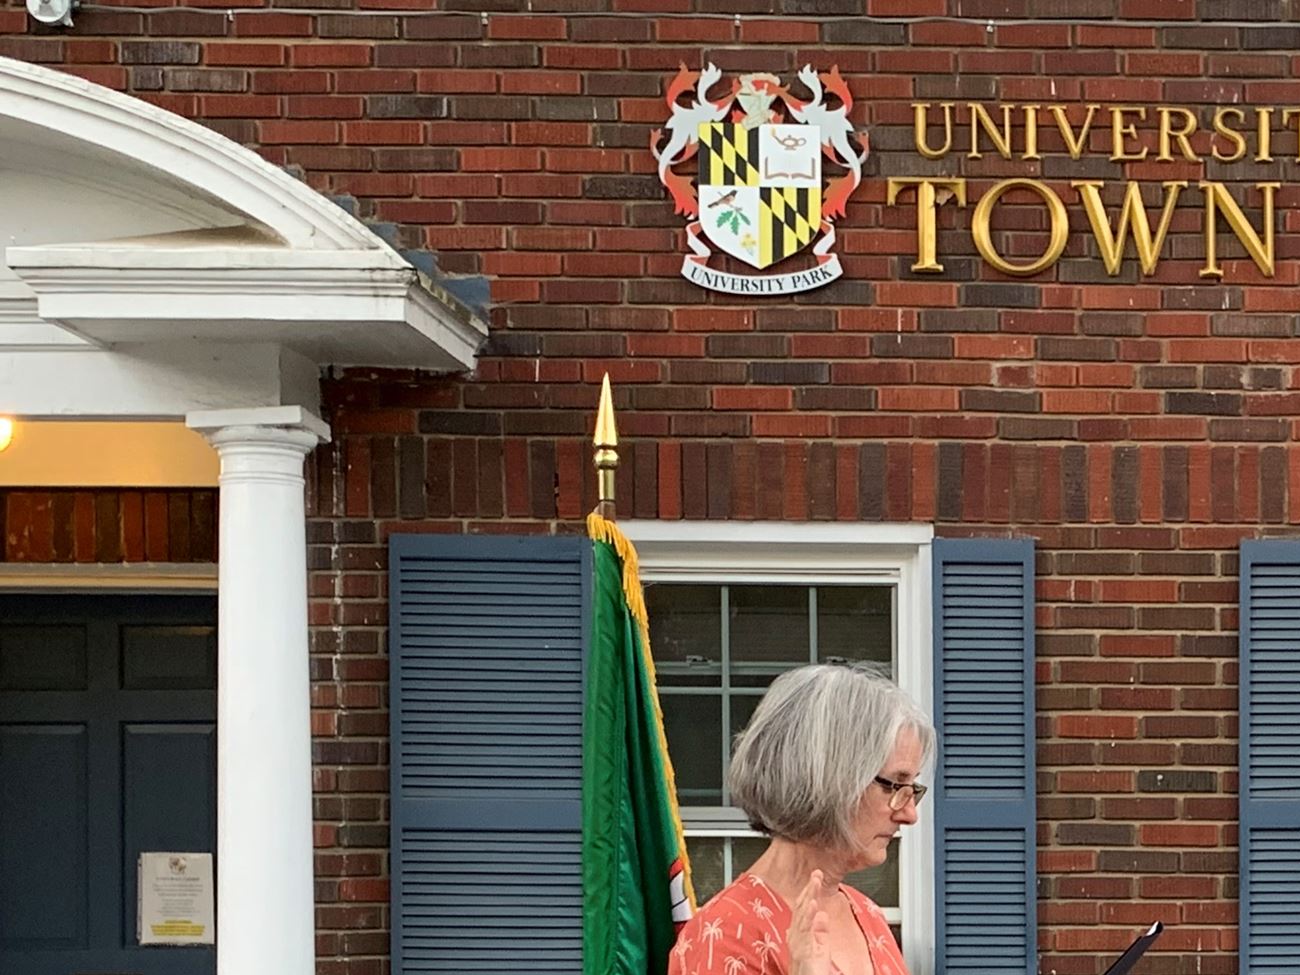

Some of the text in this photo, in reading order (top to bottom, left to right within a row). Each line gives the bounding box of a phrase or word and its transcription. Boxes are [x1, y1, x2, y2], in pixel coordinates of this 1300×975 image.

[887, 177, 1281, 278] TOWN
[691, 265, 834, 292] UNIVERSITY PARK
